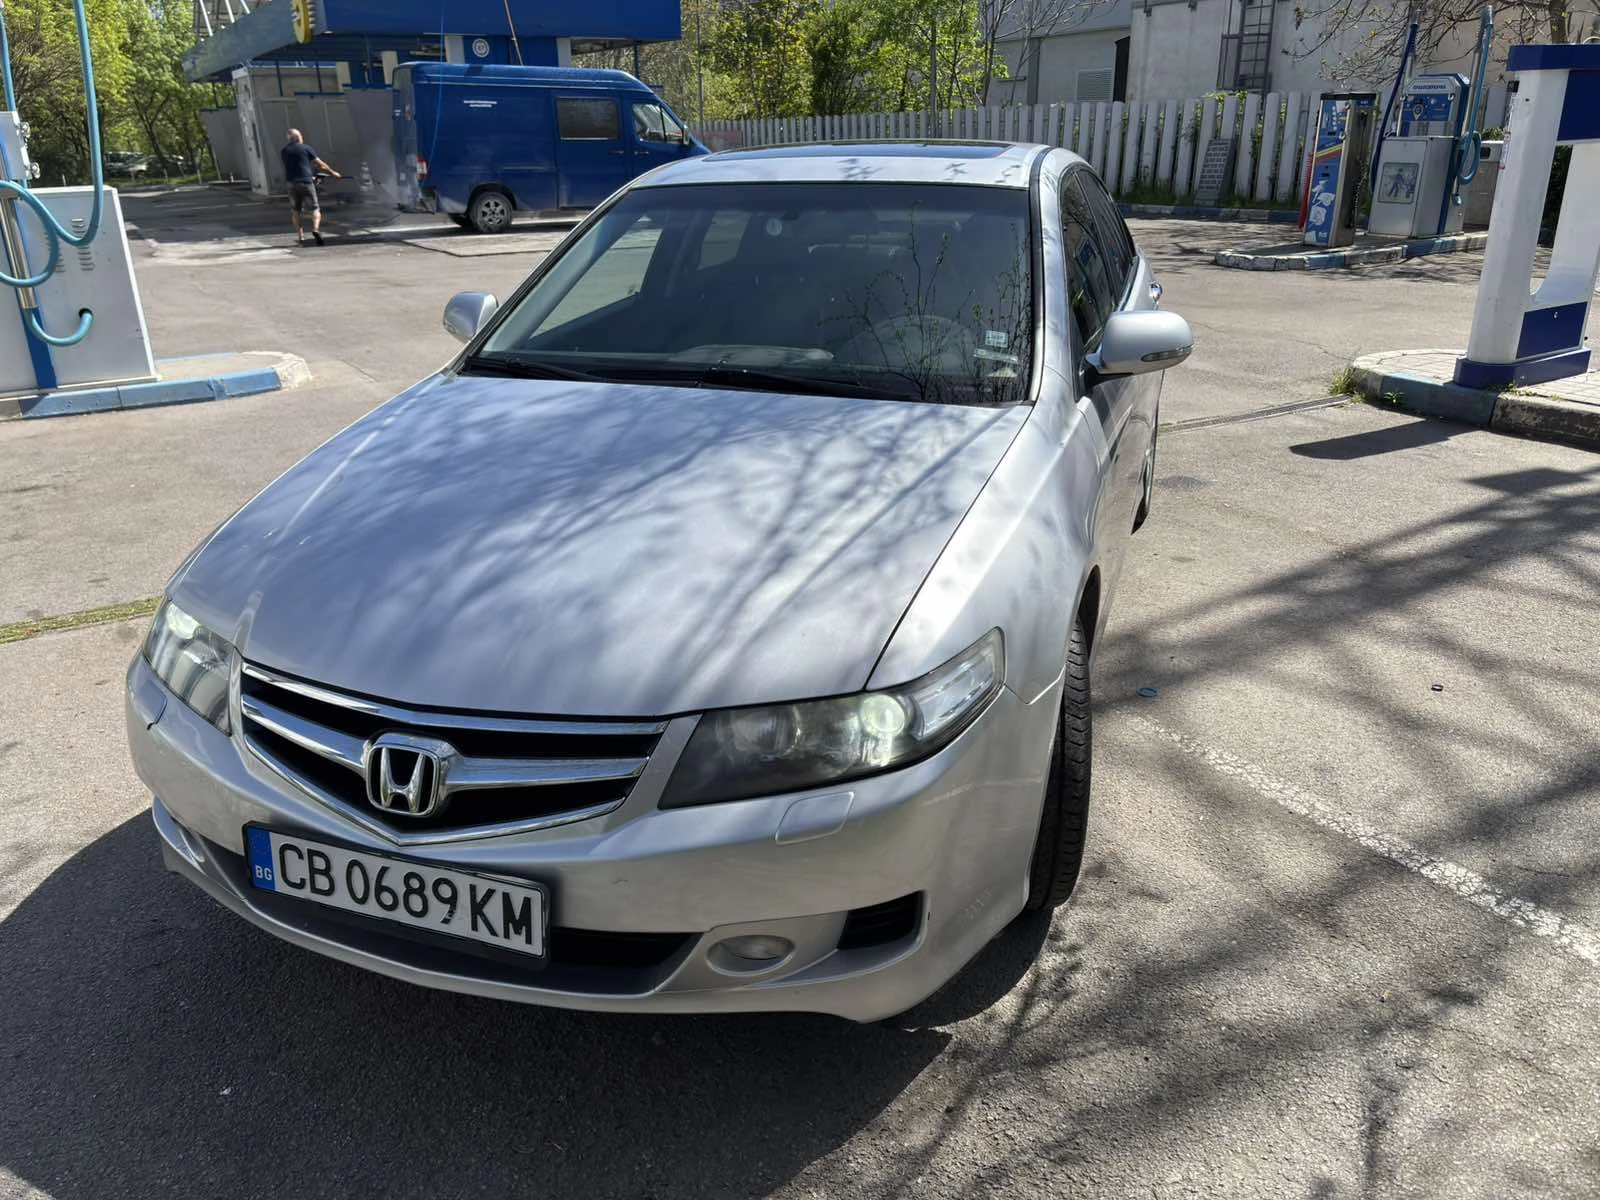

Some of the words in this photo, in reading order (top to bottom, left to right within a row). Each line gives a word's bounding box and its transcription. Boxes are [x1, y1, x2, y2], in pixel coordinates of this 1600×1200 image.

[255, 865, 273, 881] BG
[279, 843, 335, 897] CB
[346, 858, 458, 924] 0689
[469, 883, 532, 945] KM
